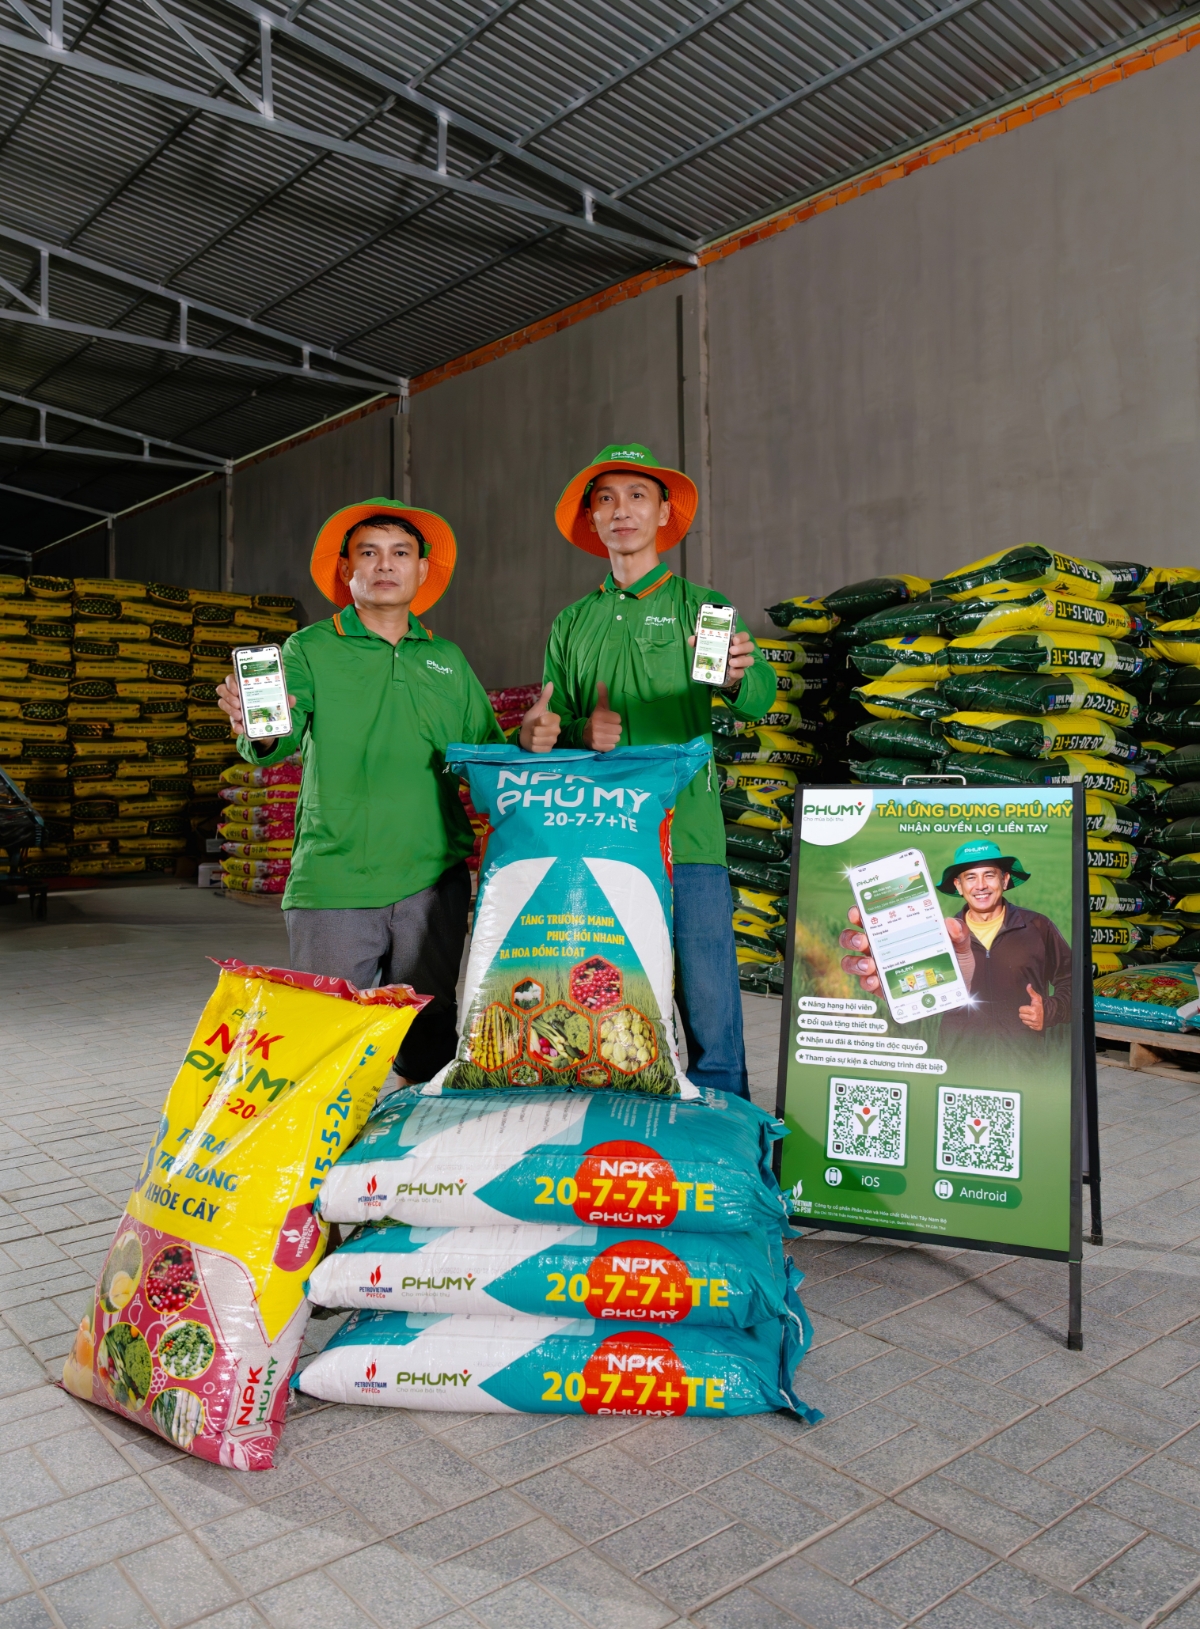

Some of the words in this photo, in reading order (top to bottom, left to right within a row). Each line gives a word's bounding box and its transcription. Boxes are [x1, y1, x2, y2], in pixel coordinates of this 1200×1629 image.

[1057, 601, 1105, 624] 20-20-15+TE
[1052, 650, 1103, 667] 20-20-15+TE
[1054, 735, 1103, 751] 20-20-15+TE
[497, 771, 595, 789] NPK
[497, 786, 585, 815] PHÚ
[593, 787, 652, 813] MỸ
[803, 802, 866, 816] PHUMY
[876, 800, 902, 817] TẢI
[907, 801, 944, 817] ỨNG
[949, 804, 1000, 821] DỤNG
[1005, 800, 1042, 817] PHÚ
[1047, 800, 1073, 817] MỸ
[543, 812, 638, 833] 20-7-7+TE
[900, 821, 930, 834] NHẬN
[934, 821, 972, 833] QUYỀN
[975, 823, 994, 834] LỢI
[998, 821, 1024, 833] LIỀN
[1027, 824, 1048, 833] TAY
[521, 914, 544, 926] TĂNG
[547, 931, 572, 943] PHỤC
[593, 932, 625, 945] NHANH
[1091, 927, 1128, 944] -20-15+TE
[500, 949, 509, 959] RA
[512, 947, 530, 958] HOA
[532, 944, 559, 957] ĐỒNG
[858, 1003, 872, 1011] viên
[204, 1023, 285, 1061] NPK
[806, 1036, 824, 1044] Nhận
[854, 1040, 874, 1048] thông
[805, 1054, 824, 1062] Tham
[825, 1055, 836, 1063] gia
[246, 1067, 297, 1103] M
[599, 1159, 655, 1179] NPK
[396, 1179, 468, 1196] PHUMY
[861, 1174, 880, 1188] iOS
[144, 1181, 180, 1211] KHỎE
[182, 1197, 220, 1223] CÂY
[534, 1177, 715, 1212] 20-7-7+TE
[959, 1186, 1007, 1203] Android
[589, 1211, 635, 1223] PHÚ
[637, 1212, 666, 1225] MỸ
[612, 1256, 668, 1275] NPK
[402, 1273, 477, 1290] PHUMY
[545, 1272, 729, 1307] 20-7-7+TE
[601, 1308, 646, 1318] PHÚ
[650, 1309, 679, 1320] MỸ
[608, 1353, 664, 1373] NPK
[397, 1369, 473, 1387] PHUMY
[236, 1366, 264, 1426] NPK
[256, 1390, 270, 1422] HÚ
[264, 1356, 279, 1386] MỸ
[541, 1372, 725, 1409] 20-7-7+TE
[597, 1407, 645, 1417] PHÚ
